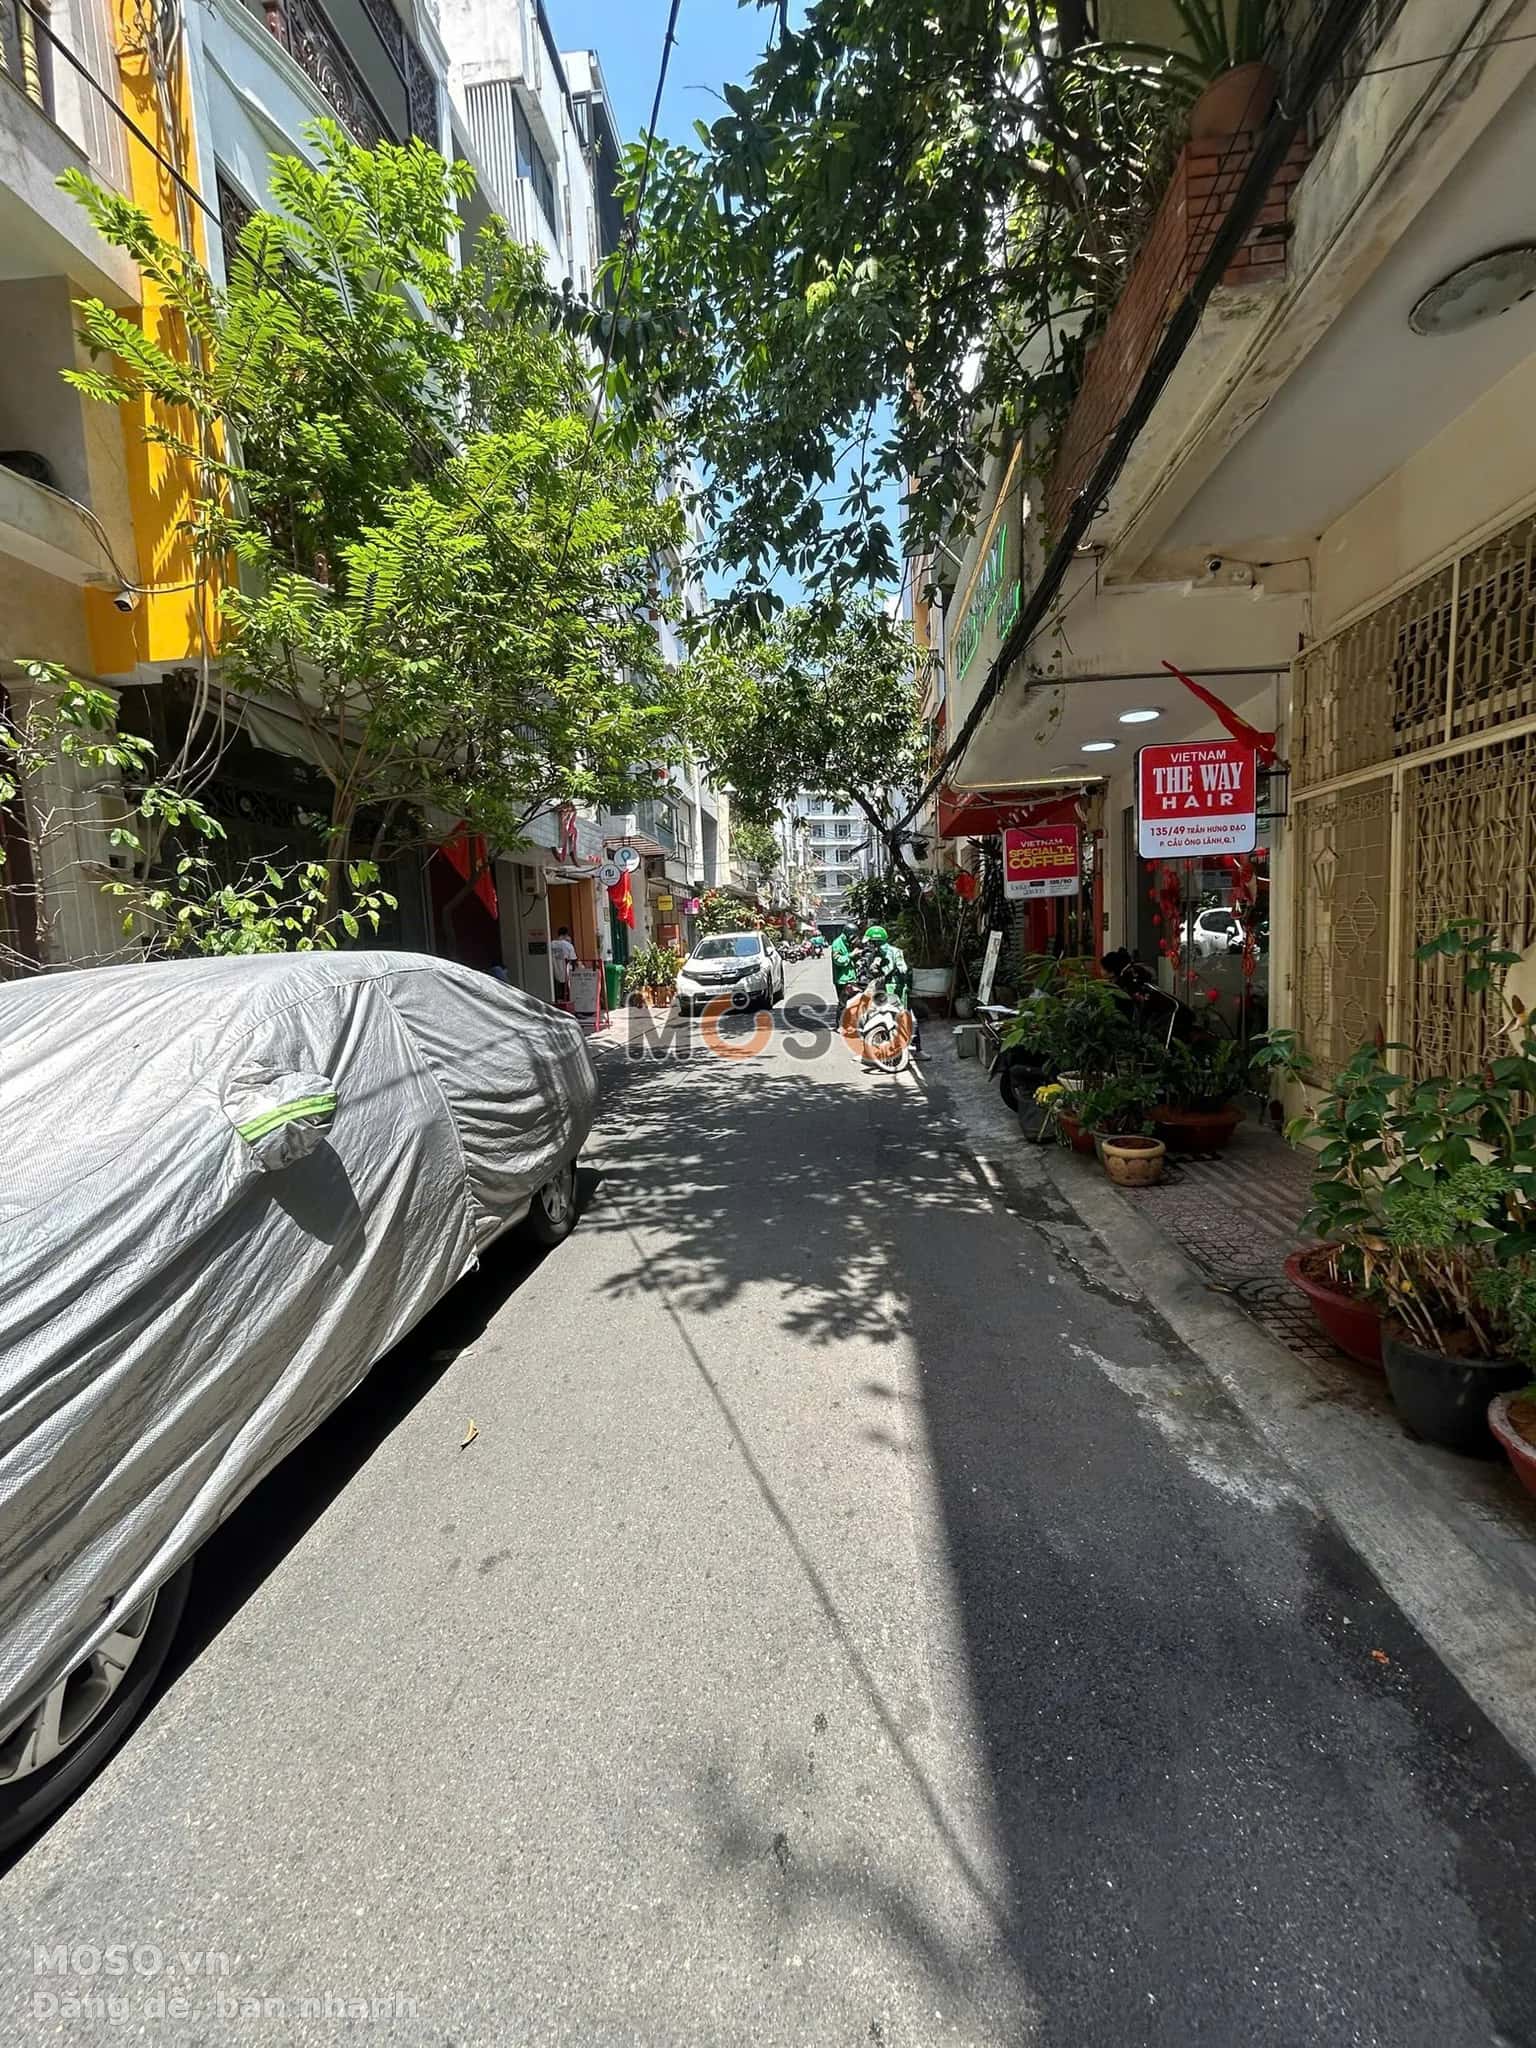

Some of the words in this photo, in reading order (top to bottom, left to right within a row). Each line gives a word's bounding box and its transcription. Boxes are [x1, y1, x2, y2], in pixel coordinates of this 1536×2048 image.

[1170, 750, 1227, 763] VIETNAM
[1153, 765, 1193, 795] THE
[1200, 762, 1244, 792] WAY
[1162, 792, 1234, 810] HAIR
[1150, 826, 1185, 837] 135/49
[1020, 838, 1063, 848] VIETNAM
[1008, 845, 1074, 858] SPECIALTY
[1008, 853, 1076, 870] COFFEE
